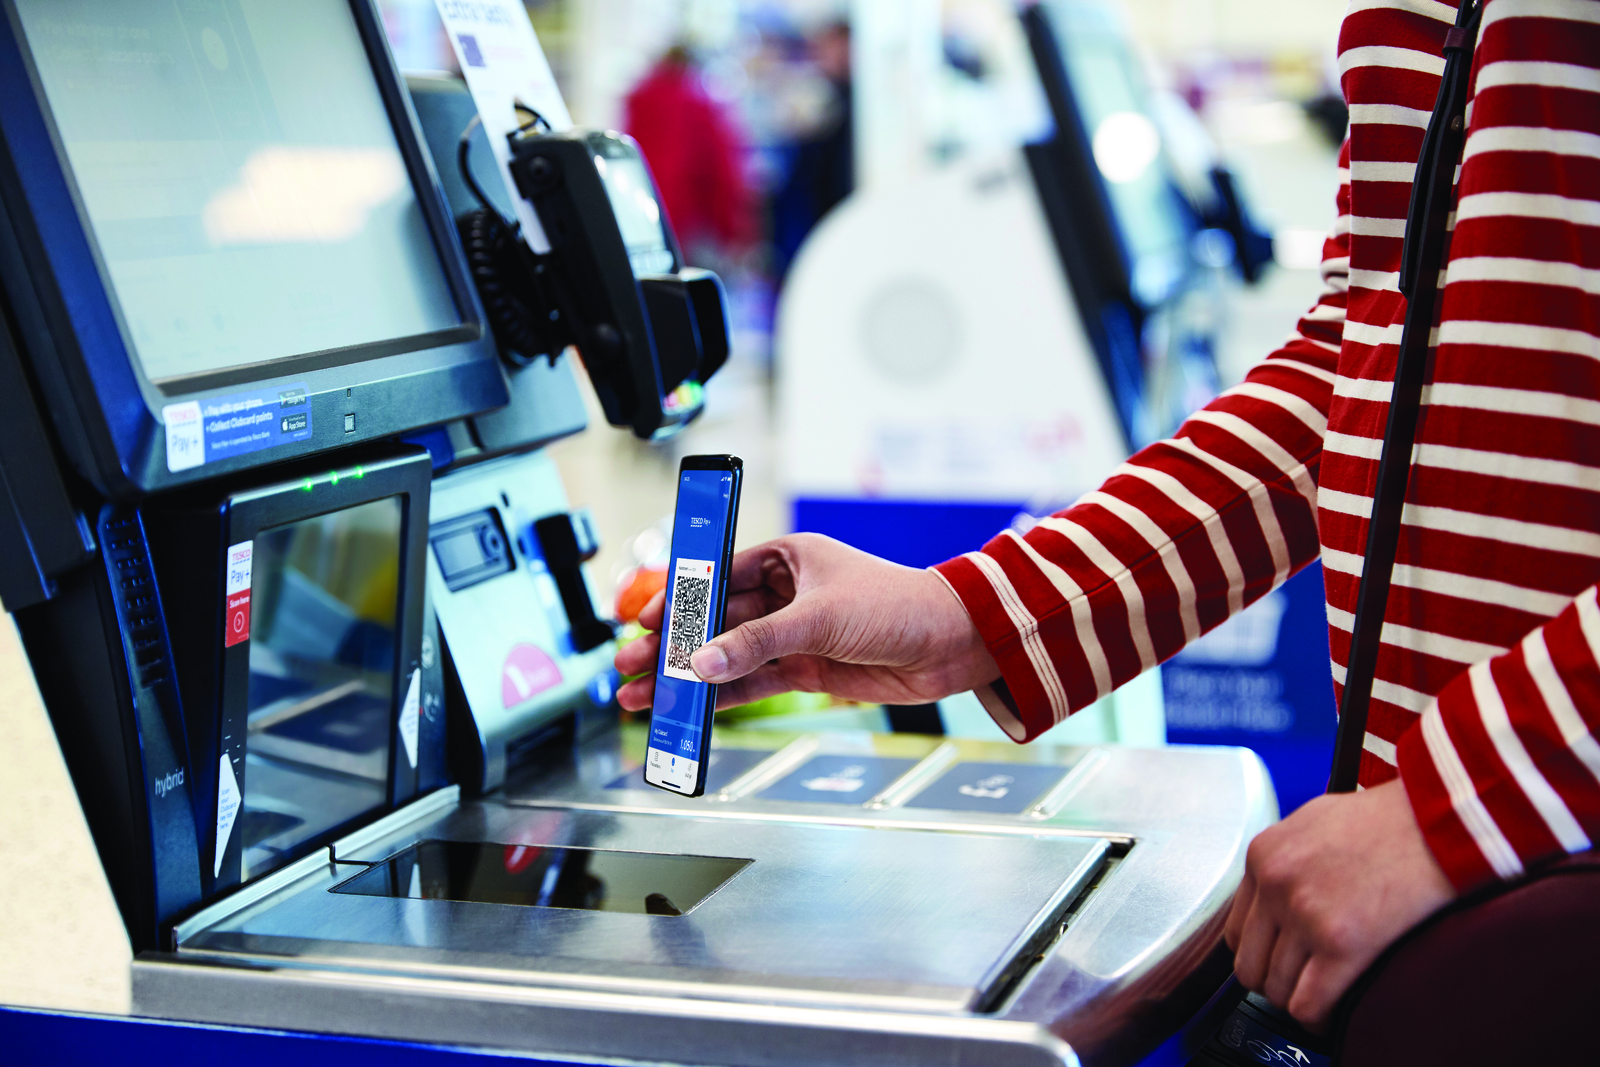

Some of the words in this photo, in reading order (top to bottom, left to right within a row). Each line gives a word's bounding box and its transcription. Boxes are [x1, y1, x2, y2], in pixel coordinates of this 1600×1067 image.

[209, 420, 230, 433] Collect
[230, 413, 255, 428] Clubcard
[255, 411, 273, 425] points
[296, 420, 306, 428] Store
[231, 548, 251, 562] TESCO
[229, 598, 240, 609] Scan
[240, 596, 250, 605] here
[154, 766, 184, 798] hybrid
